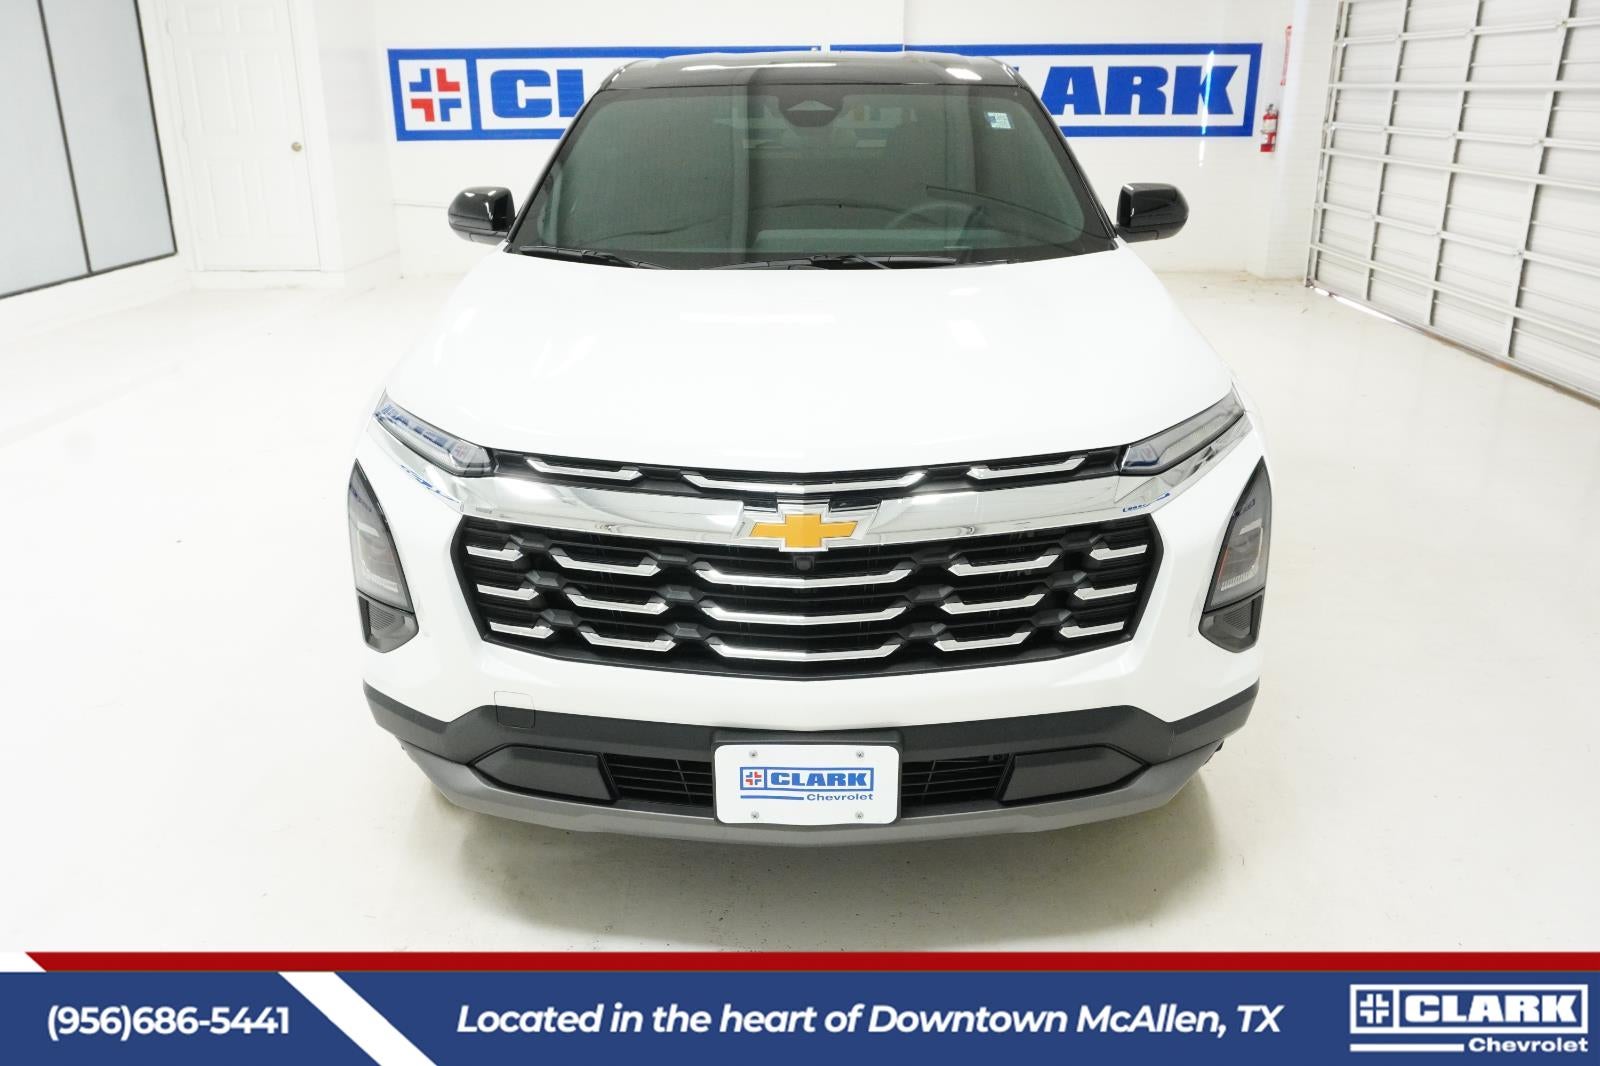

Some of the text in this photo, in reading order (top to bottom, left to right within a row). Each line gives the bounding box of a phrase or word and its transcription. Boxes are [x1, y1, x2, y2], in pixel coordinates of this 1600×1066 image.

[1013, 65, 1239, 116] ARK
[770, 772, 868, 787] CLARK
[806, 793, 874, 801] Chevrolet
